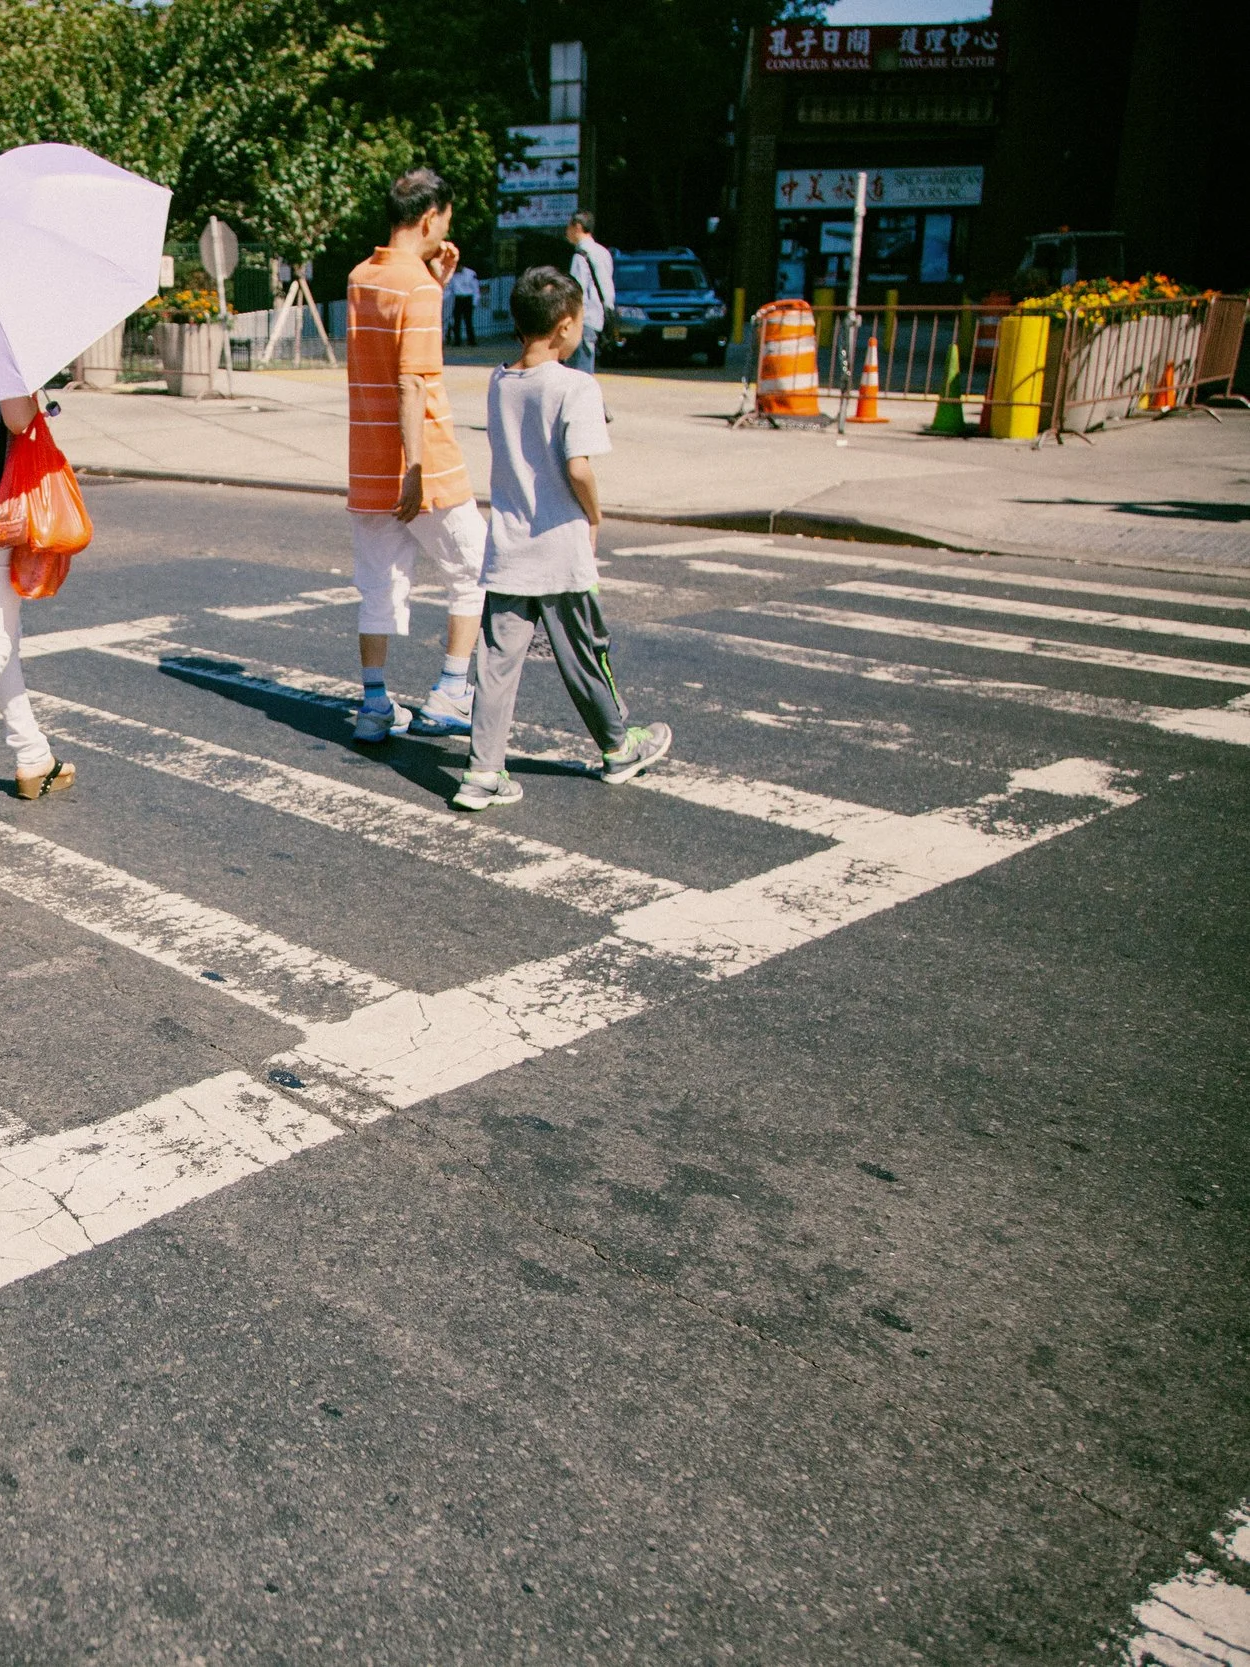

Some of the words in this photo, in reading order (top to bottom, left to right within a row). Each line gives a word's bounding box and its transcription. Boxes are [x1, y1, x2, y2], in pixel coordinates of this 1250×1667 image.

[765, 58, 829, 70] CONFUCIUS
[832, 57, 871, 70] SOCIAL
[898, 57, 948, 70] DAYCARE
[951, 56, 995, 68] CENTER
